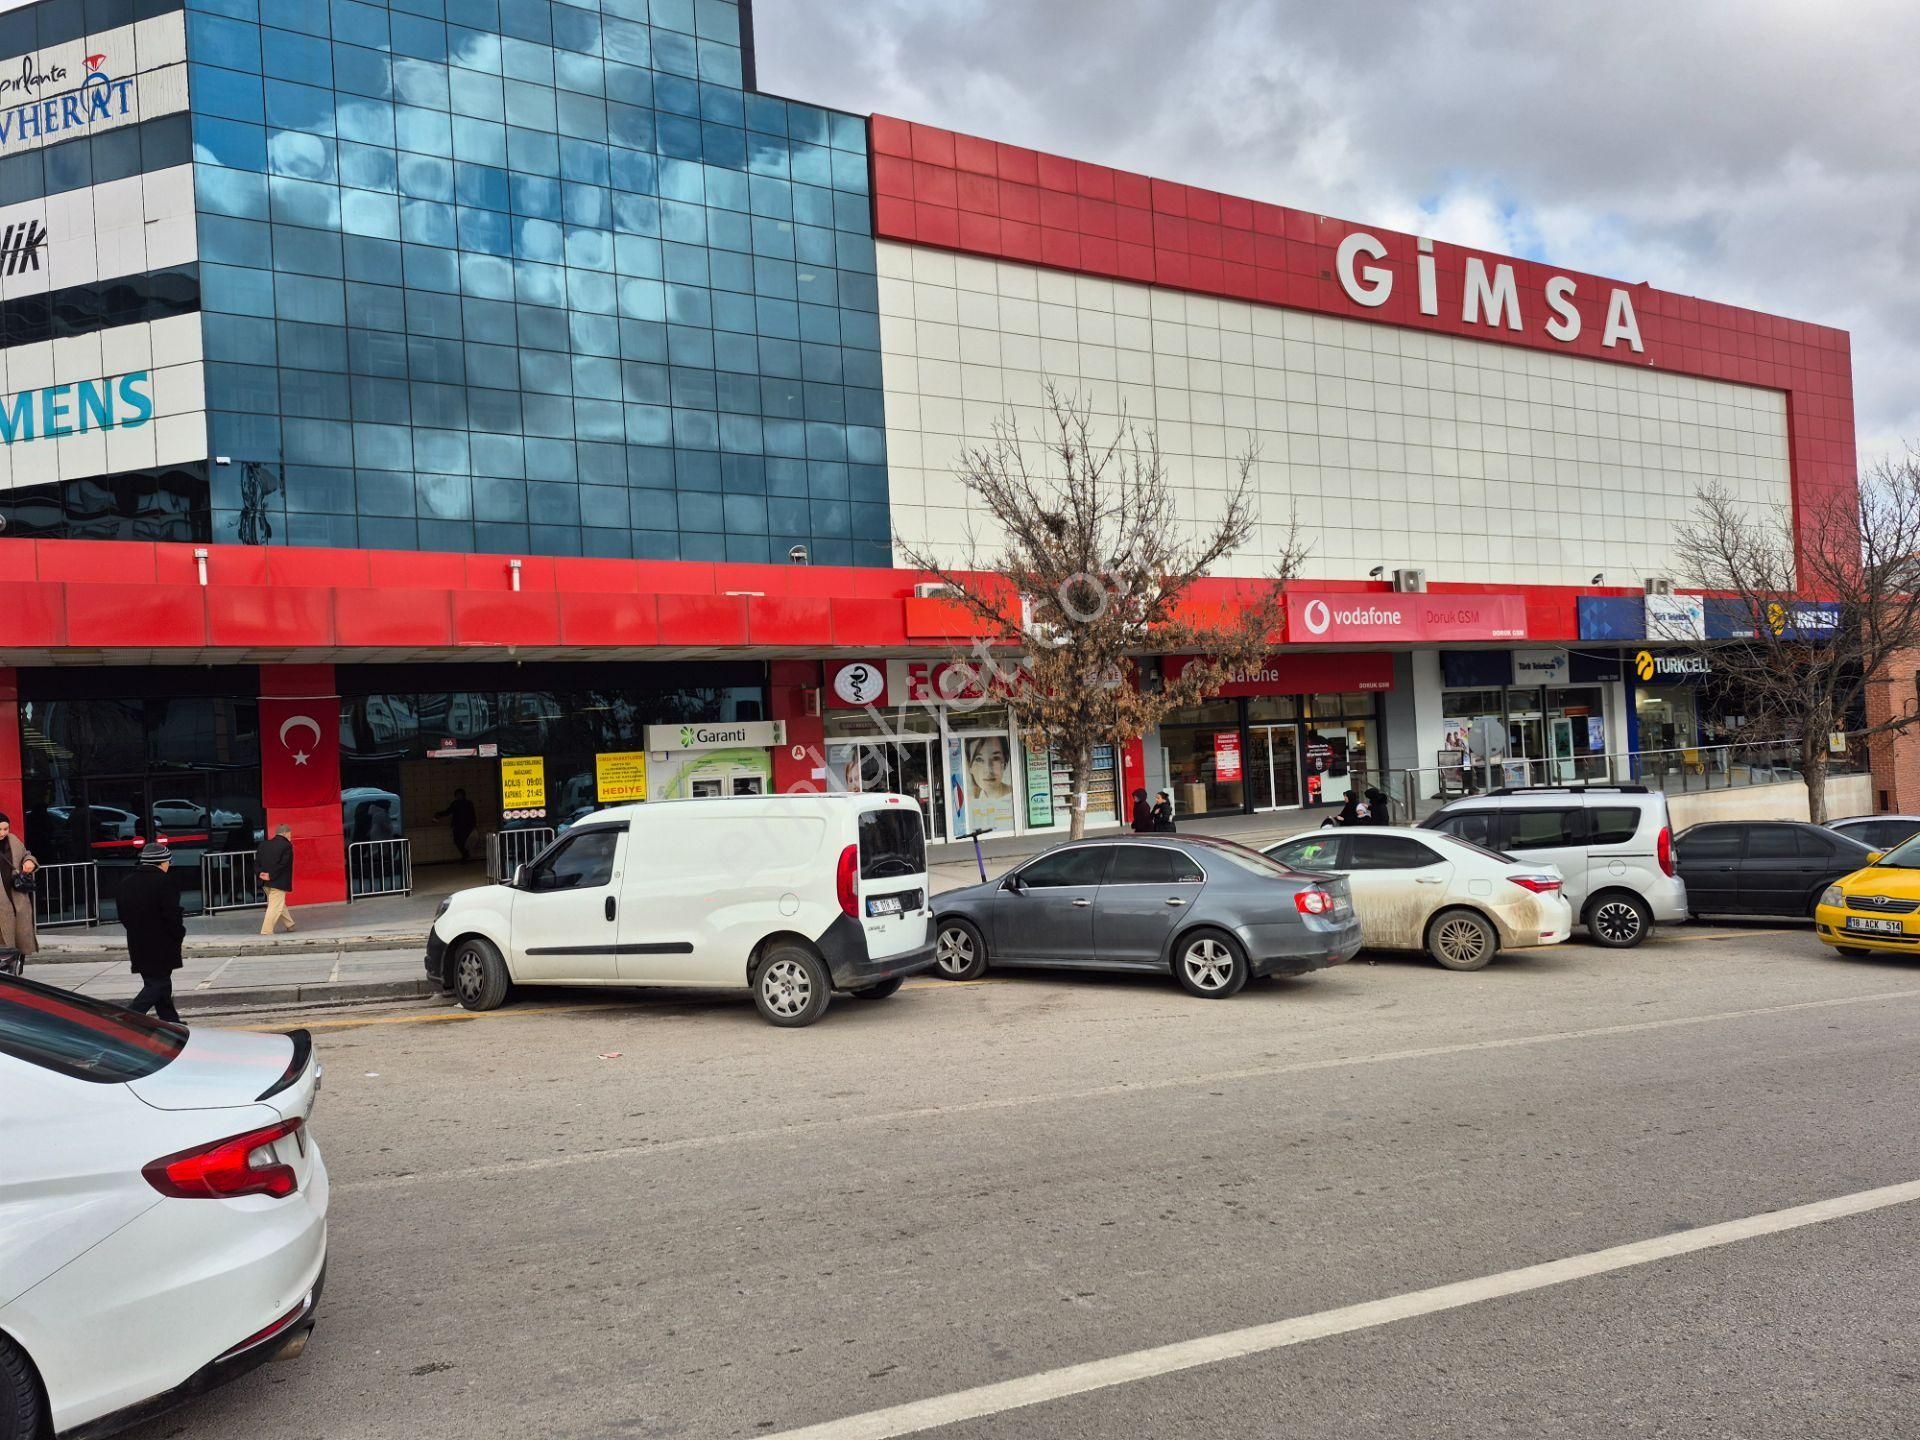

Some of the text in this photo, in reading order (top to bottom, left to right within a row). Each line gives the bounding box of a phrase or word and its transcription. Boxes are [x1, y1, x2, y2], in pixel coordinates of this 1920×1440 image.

[1336, 232, 1644, 353] GİMSA
[1334, 607, 1480, 625] vodafone Doruk GSM
[1653, 657, 1713, 674] TURKCELL
[696, 728, 746, 743] Garanti
[1864, 920, 1879, 929] ACK
[1885, 921, 1900, 931] 514
